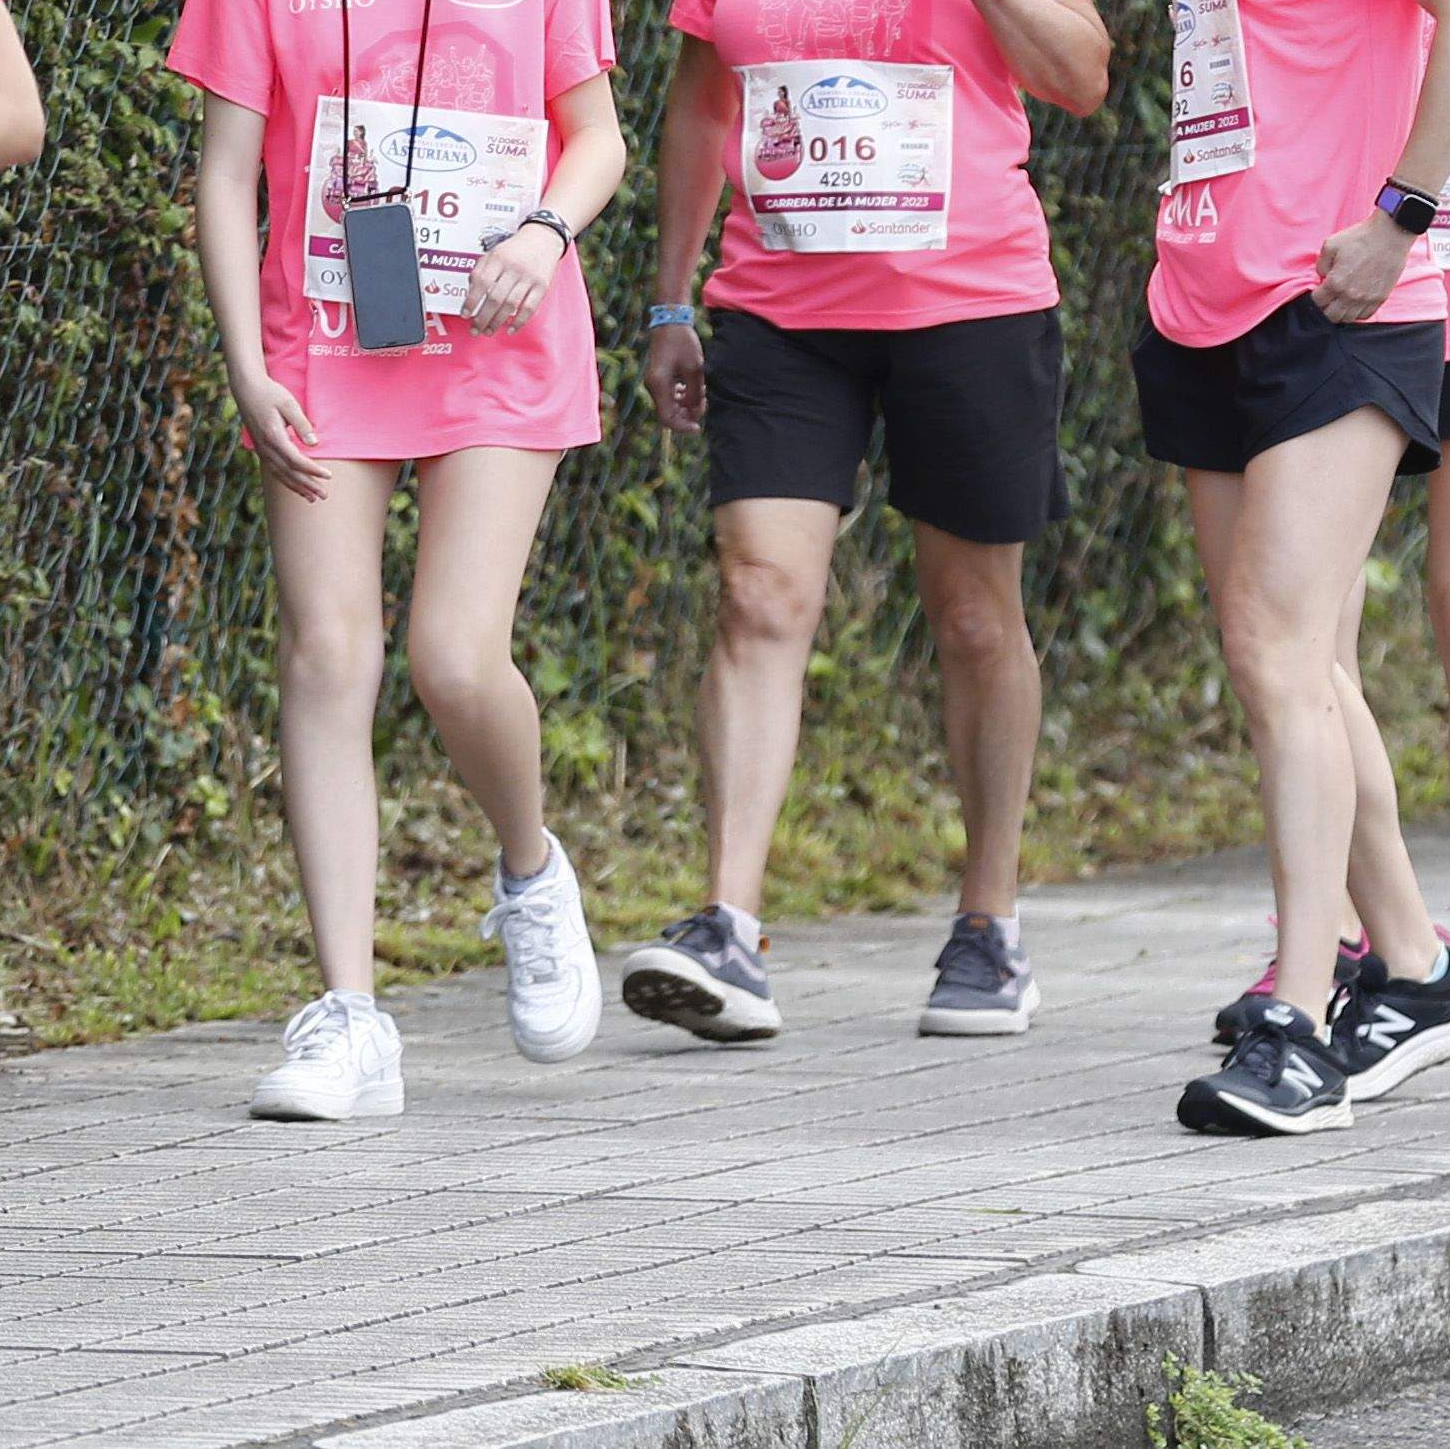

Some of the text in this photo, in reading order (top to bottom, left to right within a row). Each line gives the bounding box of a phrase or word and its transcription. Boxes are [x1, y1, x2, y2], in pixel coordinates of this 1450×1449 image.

[1199, 0, 1228, 14] SUMA
[807, 93, 881, 110] ASTURIANA
[896, 89, 937, 100] SUMA
[1174, 99, 1189, 117] 92
[1176, 114, 1240, 137] A MUJER 2023
[387, 138, 469, 164] ASTURIANA
[486, 143, 528, 158] SUMA
[809, 136, 876, 162] 016
[1196, 142, 1244, 162] Santander
[820, 171, 863, 187] 4290
[765, 196, 930, 210] CARRERA DE LA MUJER 2023
[1164, 183, 1218, 227] MA
[415, 227, 441, 245] 91
[869, 222, 931, 235] Santander
[419, 254, 477, 269] A MUJER
[422, 342, 453, 356] 2023
